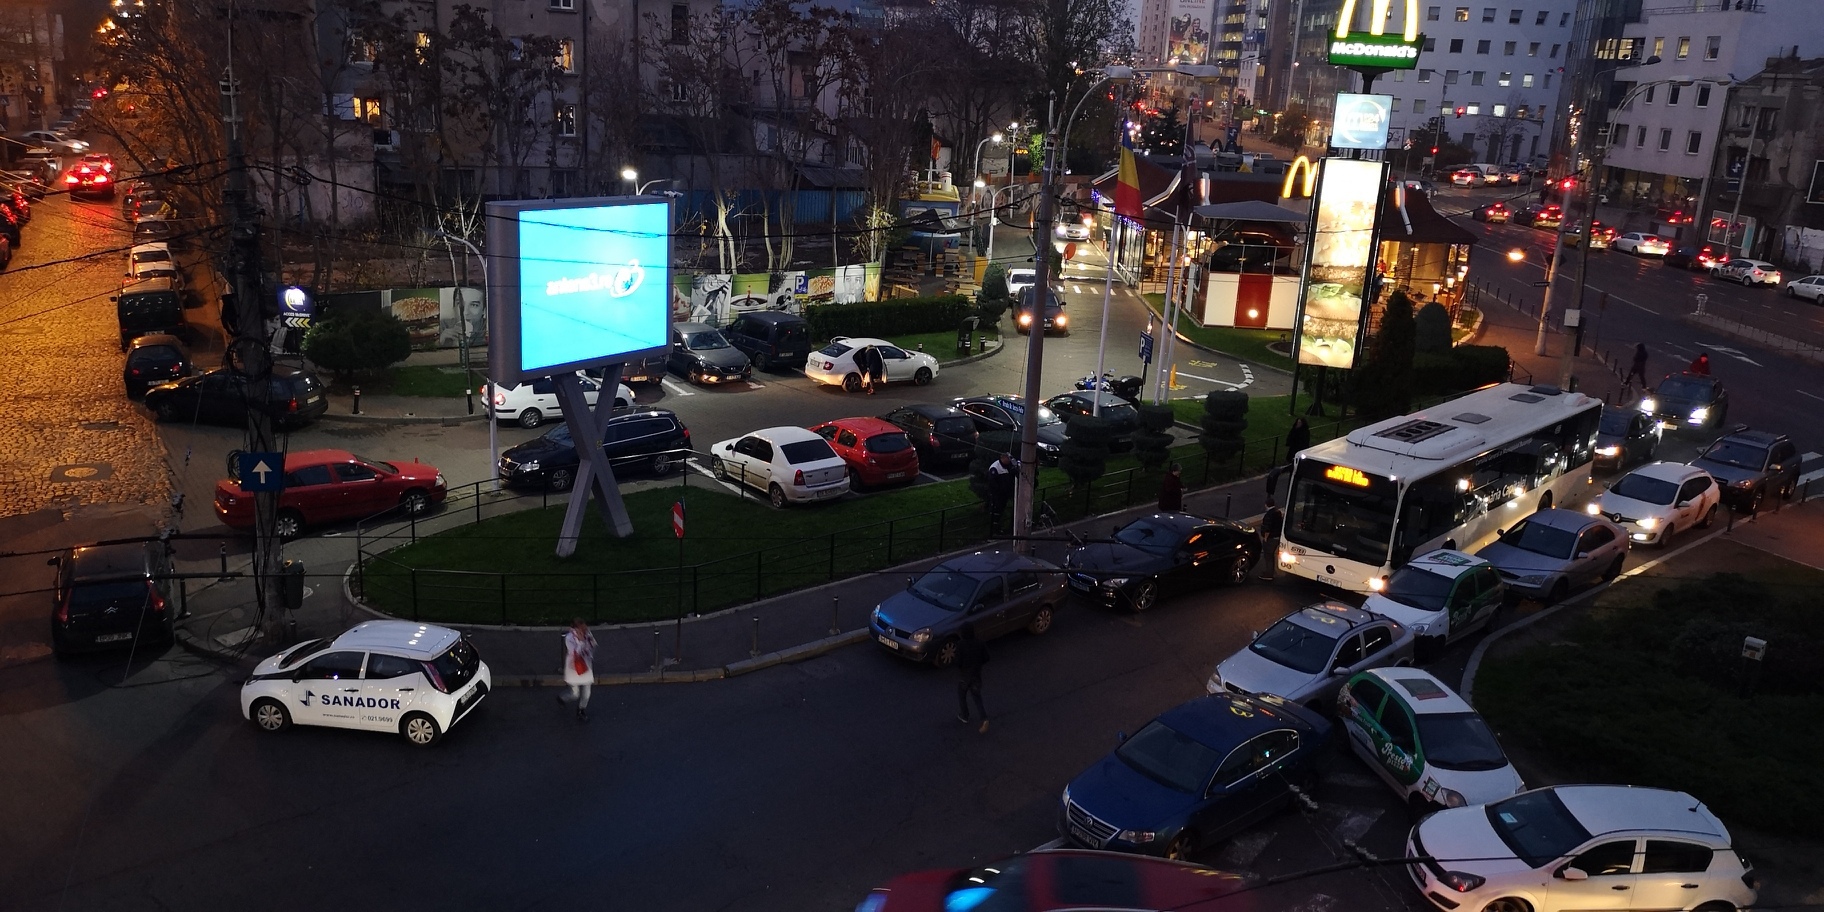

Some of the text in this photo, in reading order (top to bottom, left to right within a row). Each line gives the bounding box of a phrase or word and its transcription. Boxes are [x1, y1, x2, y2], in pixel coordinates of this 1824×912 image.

[1331, 42, 1418, 58] McDonald's
[796, 276, 805, 290] P
[1139, 336, 1146, 354] P
[321, 694, 401, 710] SANADOR
